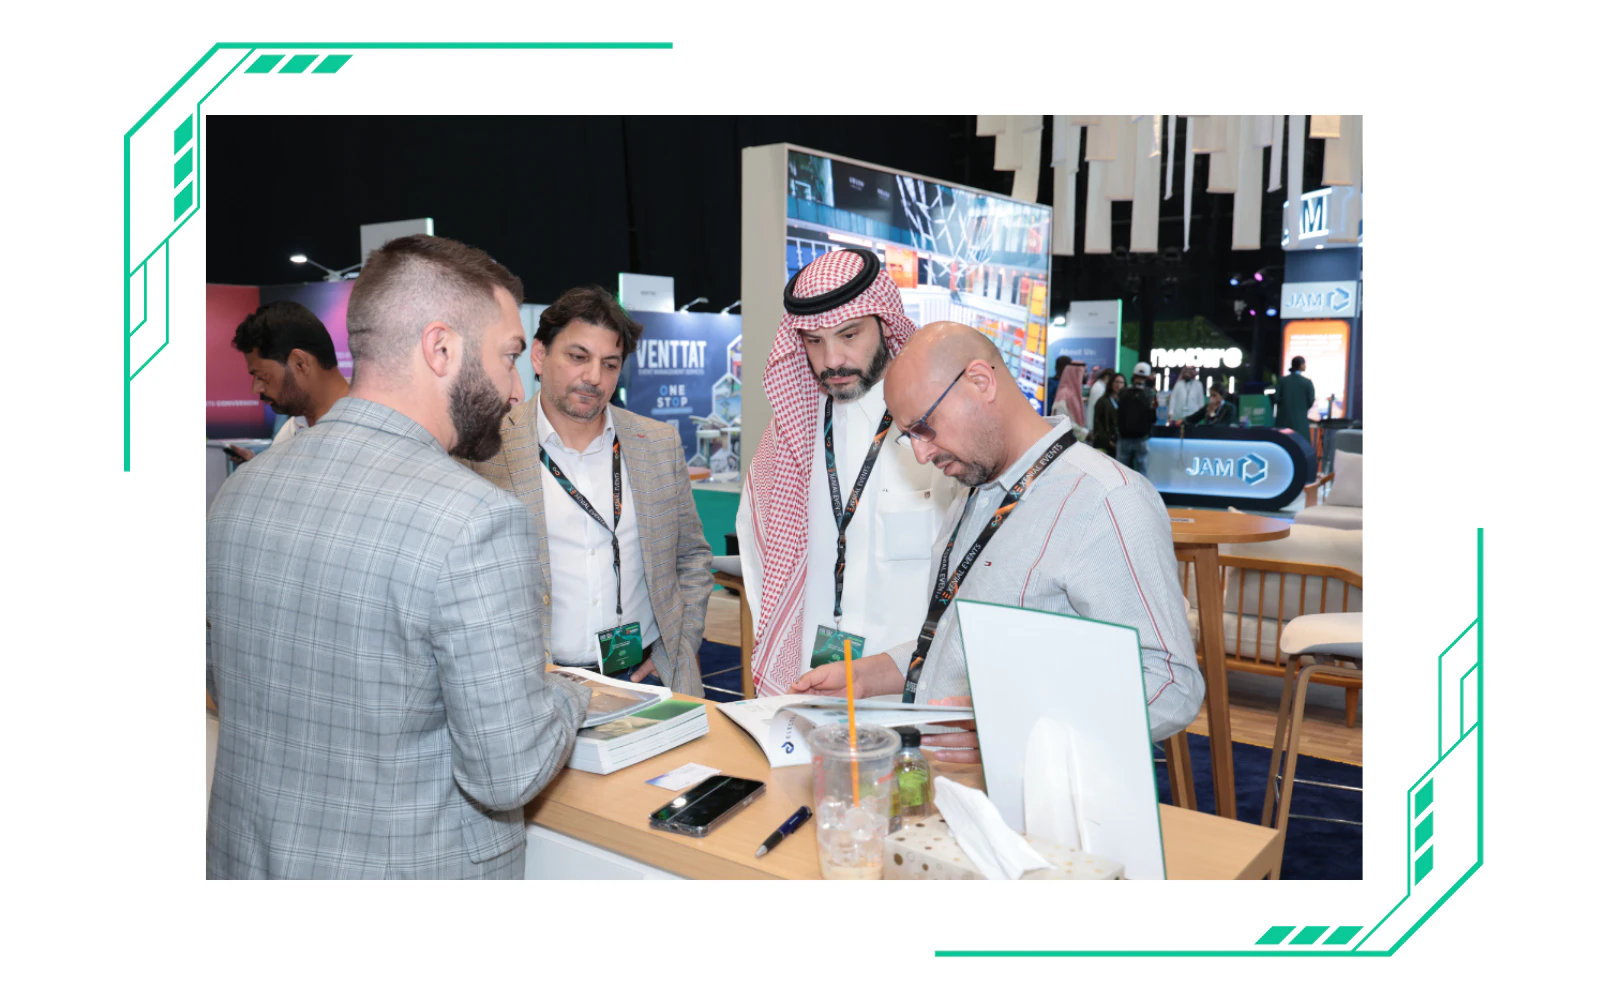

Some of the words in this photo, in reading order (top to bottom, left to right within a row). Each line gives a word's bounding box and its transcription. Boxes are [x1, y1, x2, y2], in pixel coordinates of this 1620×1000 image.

[1285, 292, 1323, 309] JAM
[636, 339, 707, 368] VENTTAT
[659, 384, 685, 396] ONE
[657, 397, 688, 408] STOP
[1039, 443, 1063, 466] EVENTS
[858, 465, 871, 487] EVENTS
[1186, 456, 1234, 477] JAM
[961, 543, 981, 569] EVENTS
